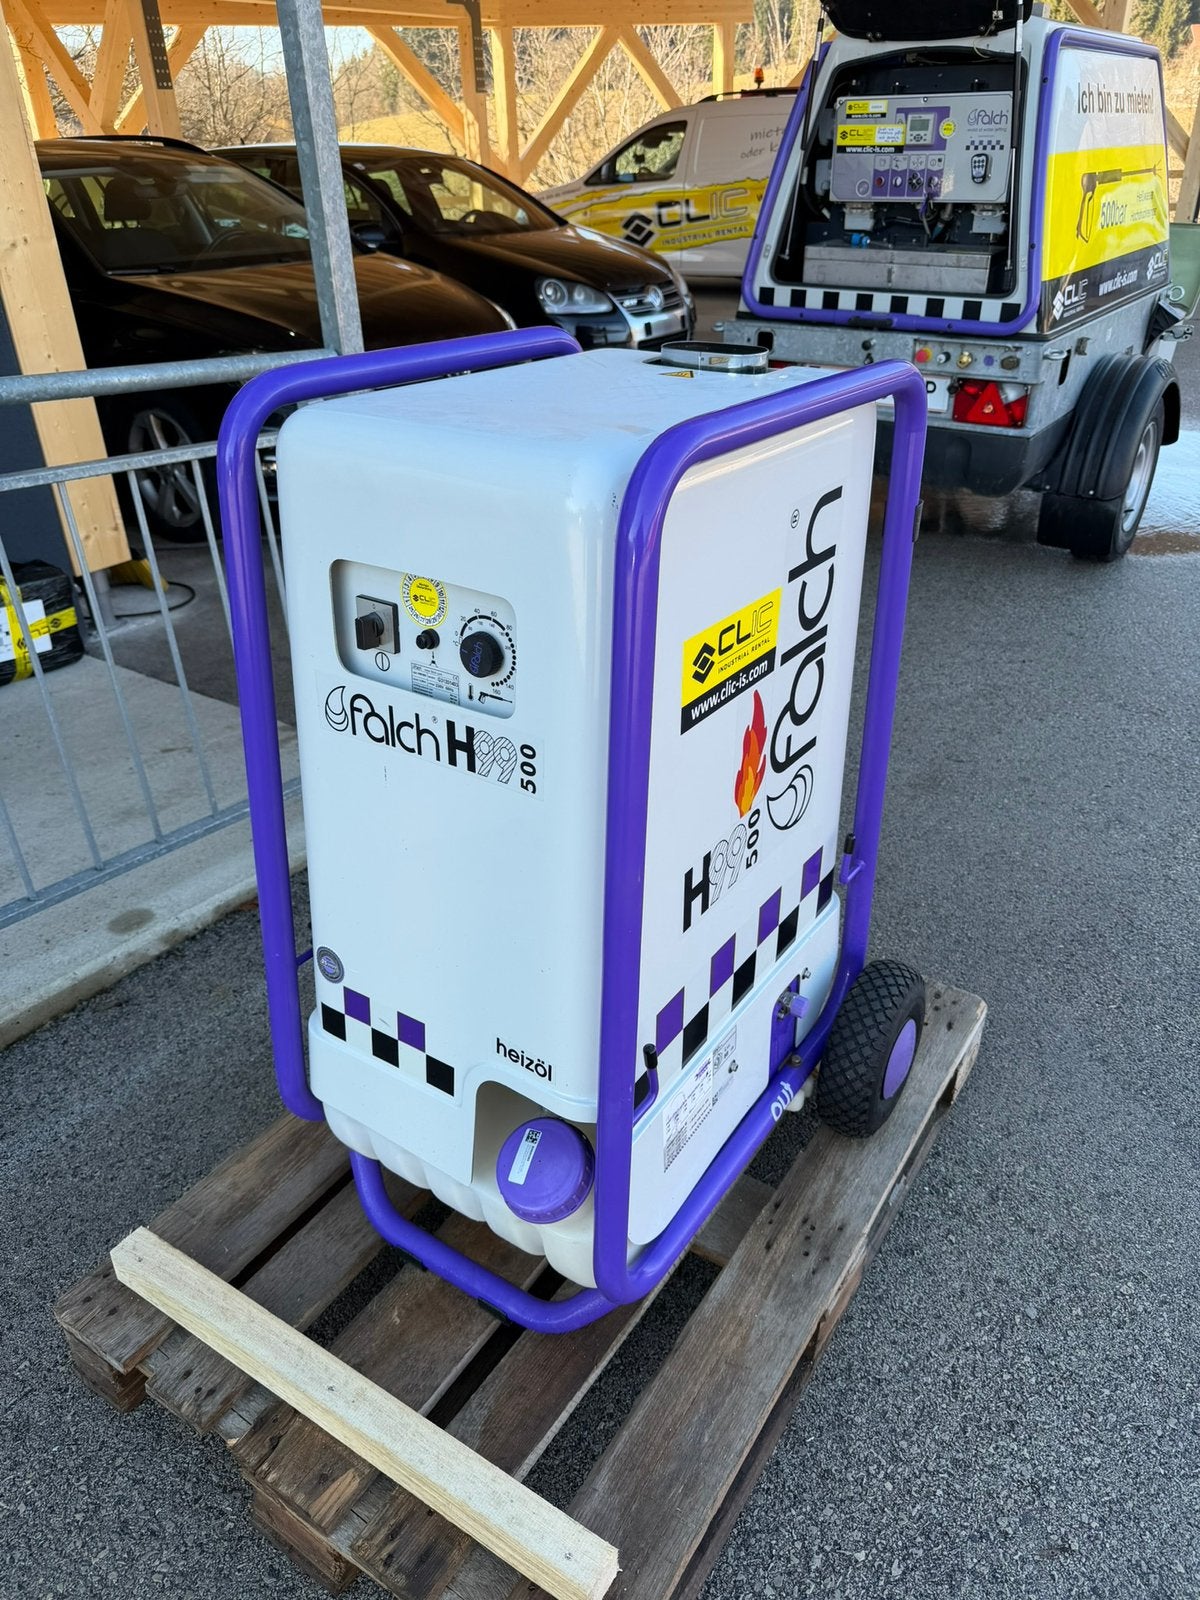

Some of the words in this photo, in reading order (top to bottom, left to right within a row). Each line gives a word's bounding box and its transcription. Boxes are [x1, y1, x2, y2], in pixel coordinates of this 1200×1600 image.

[976, 109, 1009, 125] falch
[1077, 82, 1095, 114] Ich
[1097, 83, 1112, 114] bin
[1114, 91, 1125, 114] zu
[1127, 86, 1154, 115] mieten!
[740, 146, 765, 159] oder
[655, 187, 750, 229] CLIC
[661, 231, 713, 247] INDUSTRIAL
[715, 224, 750, 240] RENTAL
[718, 601, 774, 656] CLIC
[769, 484, 844, 774] falch
[718, 651, 750, 674] INDUSTRIAL
[751, 636, 771, 652] RENTAL
[690, 659, 769, 721] www.clic-is.com
[446, 719, 518, 785] H99
[519, 743, 537, 795] 500
[745, 808, 761, 870] 500
[682, 823, 748, 934] H99
[495, 1036, 553, 1082] heizöl
